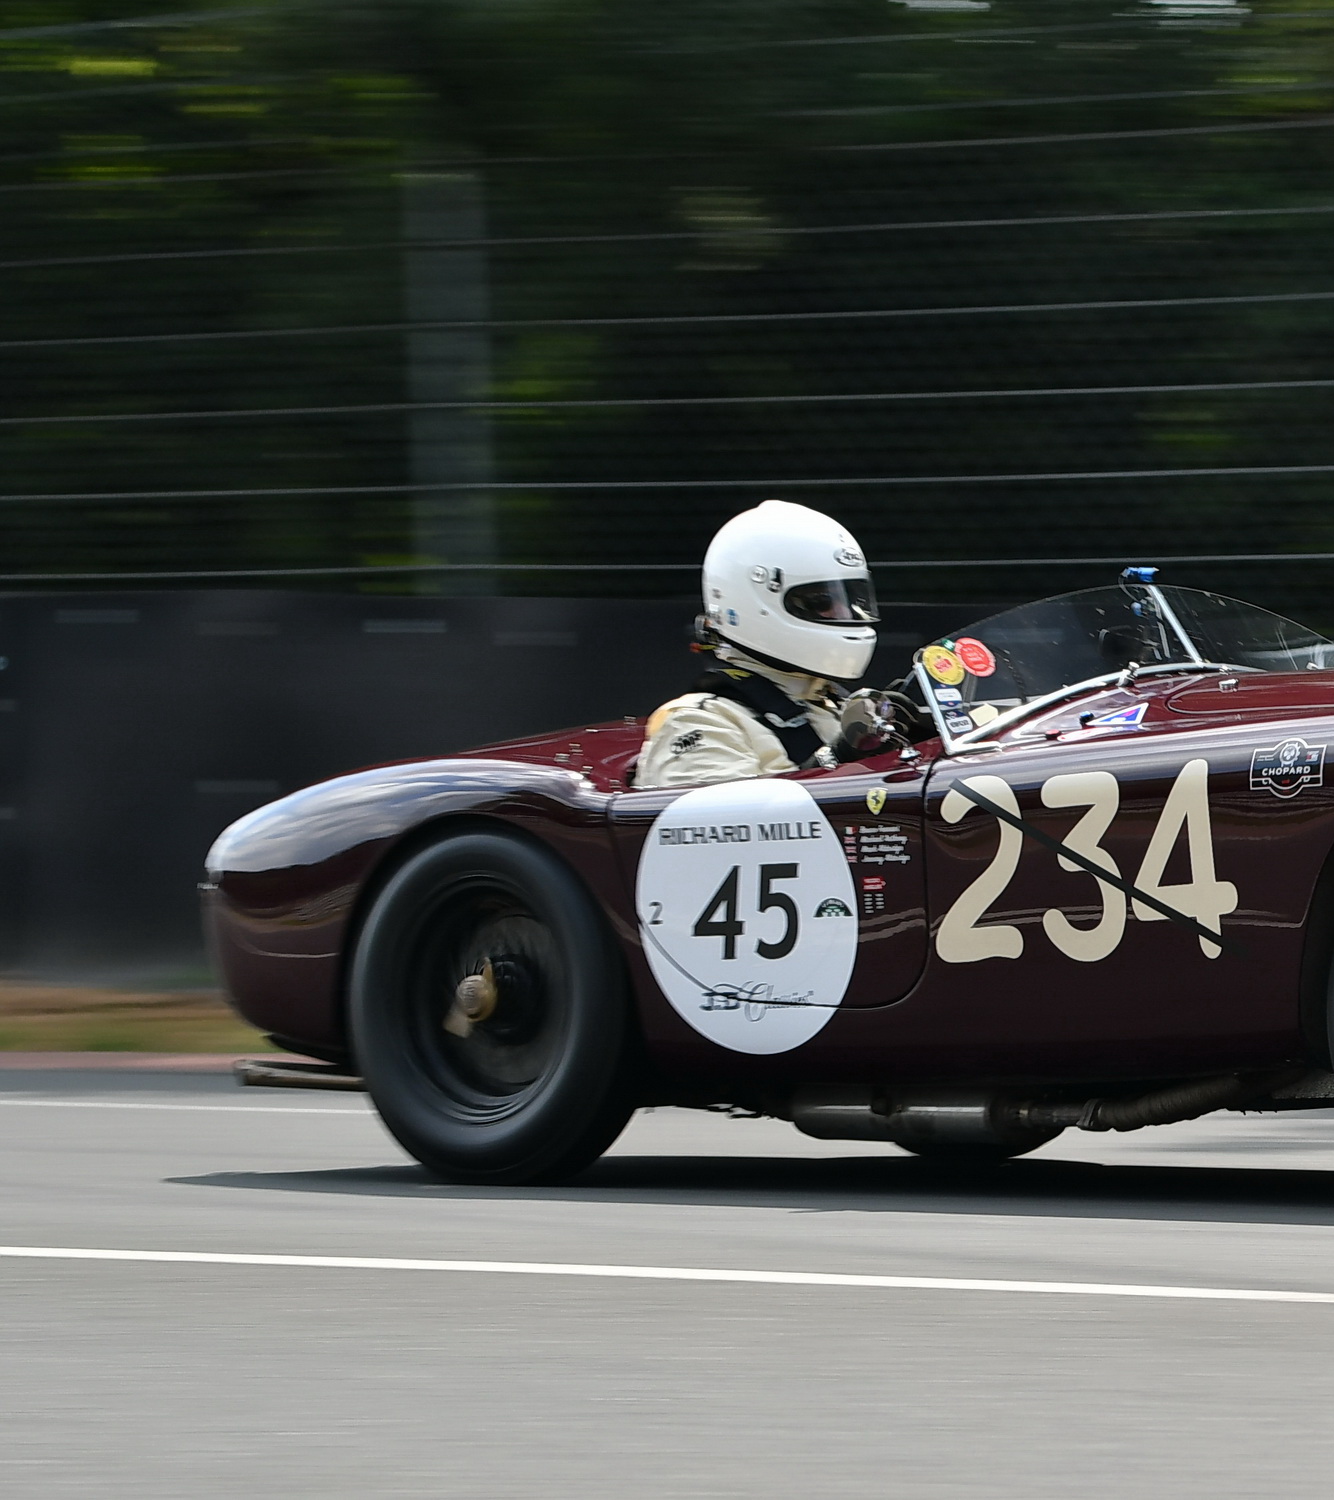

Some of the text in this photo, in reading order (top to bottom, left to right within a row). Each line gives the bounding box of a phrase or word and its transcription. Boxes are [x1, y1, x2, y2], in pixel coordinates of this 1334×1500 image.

[1262, 766, 1311, 776] CHOPARD
[659, 821, 822, 845] RICHARD MILLE
[936, 759, 1238, 963] 234
[649, 902, 663, 925] 2
[691, 862, 800, 960] 45
